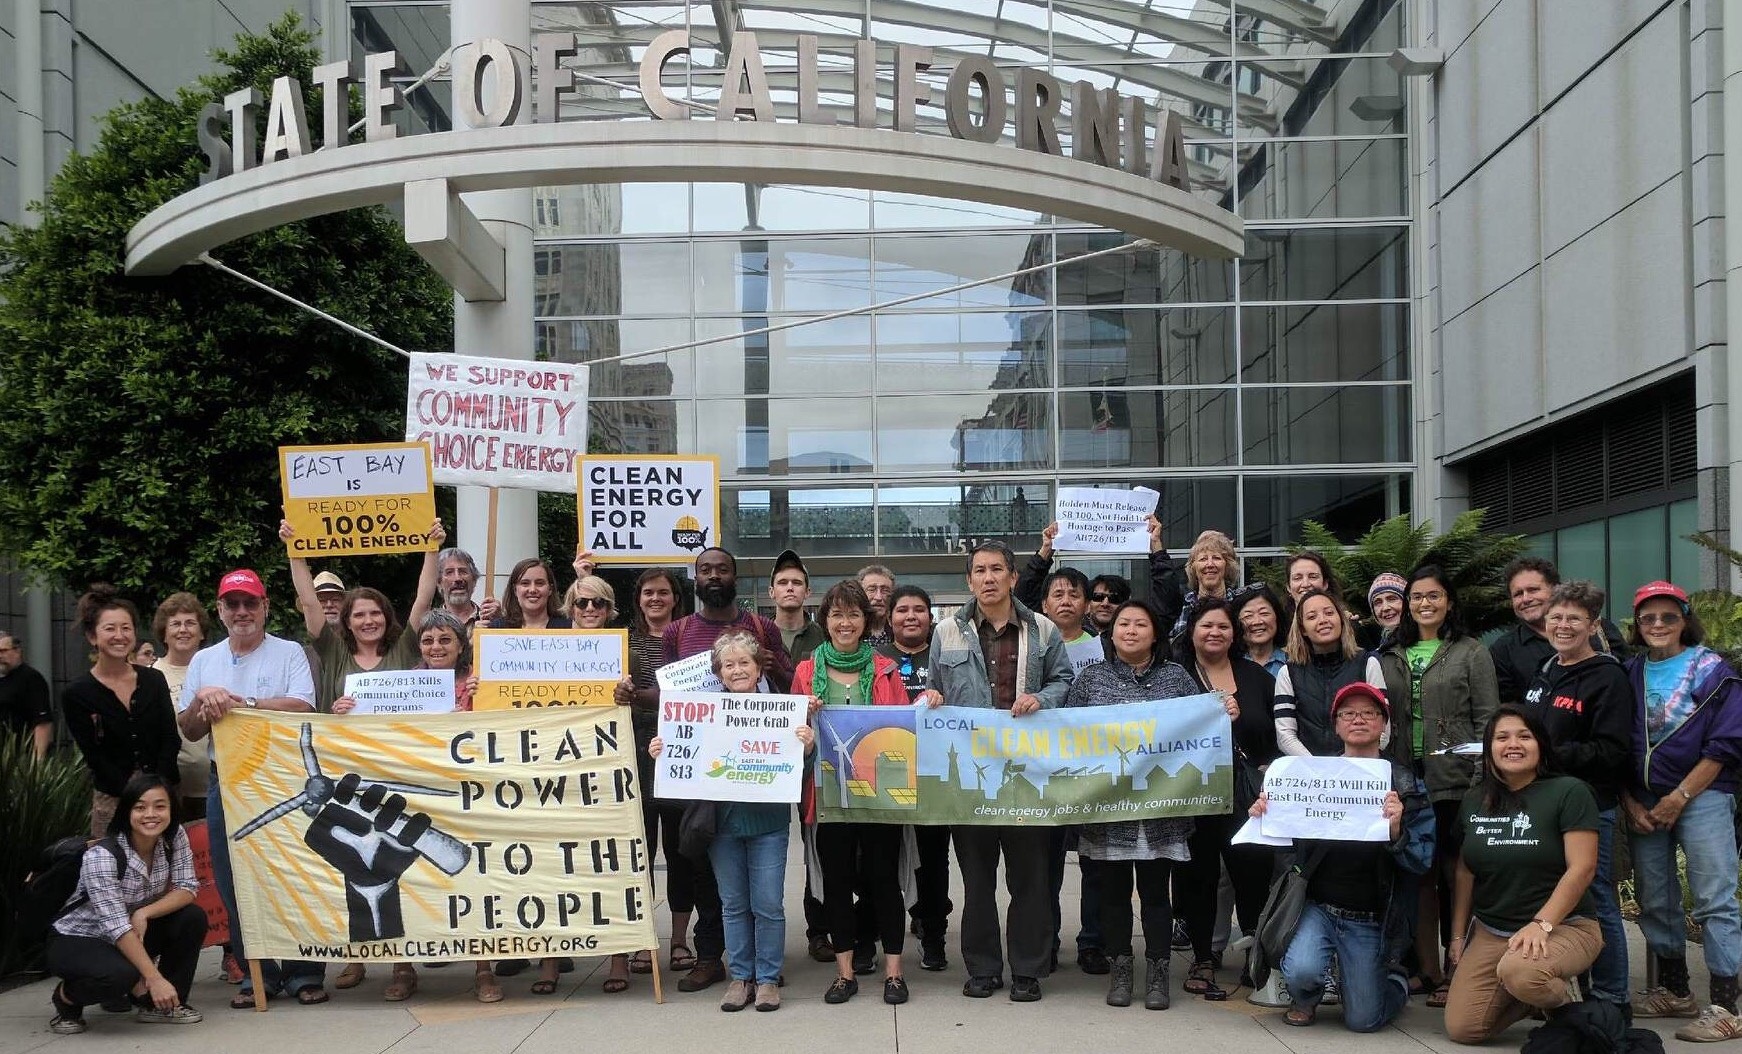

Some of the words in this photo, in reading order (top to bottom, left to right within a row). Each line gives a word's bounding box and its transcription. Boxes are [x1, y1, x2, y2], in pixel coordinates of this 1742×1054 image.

[198, 50, 403, 187] STATE
[458, 33, 578, 129] OF
[639, 30, 1192, 193] CALIFORNIA
[425, 362, 459, 382] WE
[467, 365, 576, 392] SUPPORT
[416, 389, 577, 436] COMMUNITY
[502, 443, 578, 473] ENERGY
[293, 454, 345, 480] EAST
[366, 454, 405, 475] BAY
[590, 467, 683, 485] CLEAN
[347, 479, 361, 491] IS
[308, 499, 367, 514] READY
[375, 498, 411, 511] FOR
[591, 488, 703, 507] ENERGY
[1059, 499, 1089, 509] Holden
[1092, 501, 1113, 509] Must
[1115, 502, 1147, 512] Release
[322, 513, 400, 536] 100%
[591, 510, 647, 528] FOR
[1062, 510, 1073, 519] SB
[1097, 513, 1111, 521] Not
[1113, 514, 1134, 522] Hold
[1067, 521, 1102, 532] Hostage
[1117, 523, 1136, 532] Pass
[293, 537, 354, 551] CLEAN
[360, 533, 432, 549] ENERGY
[591, 531, 643, 550] ALL
[500, 637, 537, 654] SAVE
[541, 639, 571, 650] EAST
[577, 638, 600, 654] BAY
[490, 659, 560, 674] COMMUNITY
[565, 658, 621, 675] ENERGY!
[664, 660, 709, 680] Corporate
[356, 678, 370, 688] AB
[373, 677, 416, 688] 726/813
[418, 676, 442, 686] Kills
[673, 672, 704, 687] Energy
[351, 690, 410, 701] Community
[412, 690, 447, 699] Choice
[499, 684, 560, 698] READY
[567, 684, 604, 697] FOR
[373, 703, 425, 714] programs
[663, 701, 716, 723] STOP!
[721, 699, 741, 711] The
[744, 699, 797, 713] Corporate
[726, 715, 761, 728] Power
[764, 714, 790, 728] Grab
[924, 718, 979, 731] LOCAL
[675, 725, 694, 740] AB
[970, 725, 1049, 759] CLEAN
[1059, 718, 1157, 758] ENERGY
[450, 720, 619, 764] CLEAN
[741, 739, 782, 755] SAVE
[1135, 736, 1222, 756] ALLIANCE
[666, 744, 700, 760] 726/
[669, 764, 694, 780] 813
[726, 769, 778, 785] energy
[736, 762, 795, 775] community
[461, 767, 636, 811] POWER
[1267, 777, 1282, 787] AB
[1285, 778, 1336, 789] 726/813
[1339, 779, 1363, 790] Will
[1367, 780, 1387, 790] Kill
[973, 804, 1008, 816] clean
[1009, 805, 1051, 819] energy
[1053, 802, 1080, 818] jobs
[1082, 803, 1091, 813] &
[1095, 799, 1141, 815] healthy
[1144, 794, 1224, 809] communities
[1266, 791, 1290, 802] East
[1294, 792, 1314, 805] Bay
[1317, 793, 1386, 808] Community
[1305, 807, 1347, 821] Energy
[472, 841, 533, 876] TO
[559, 838, 646, 875] THE
[448, 886, 644, 930] PEOPLE
